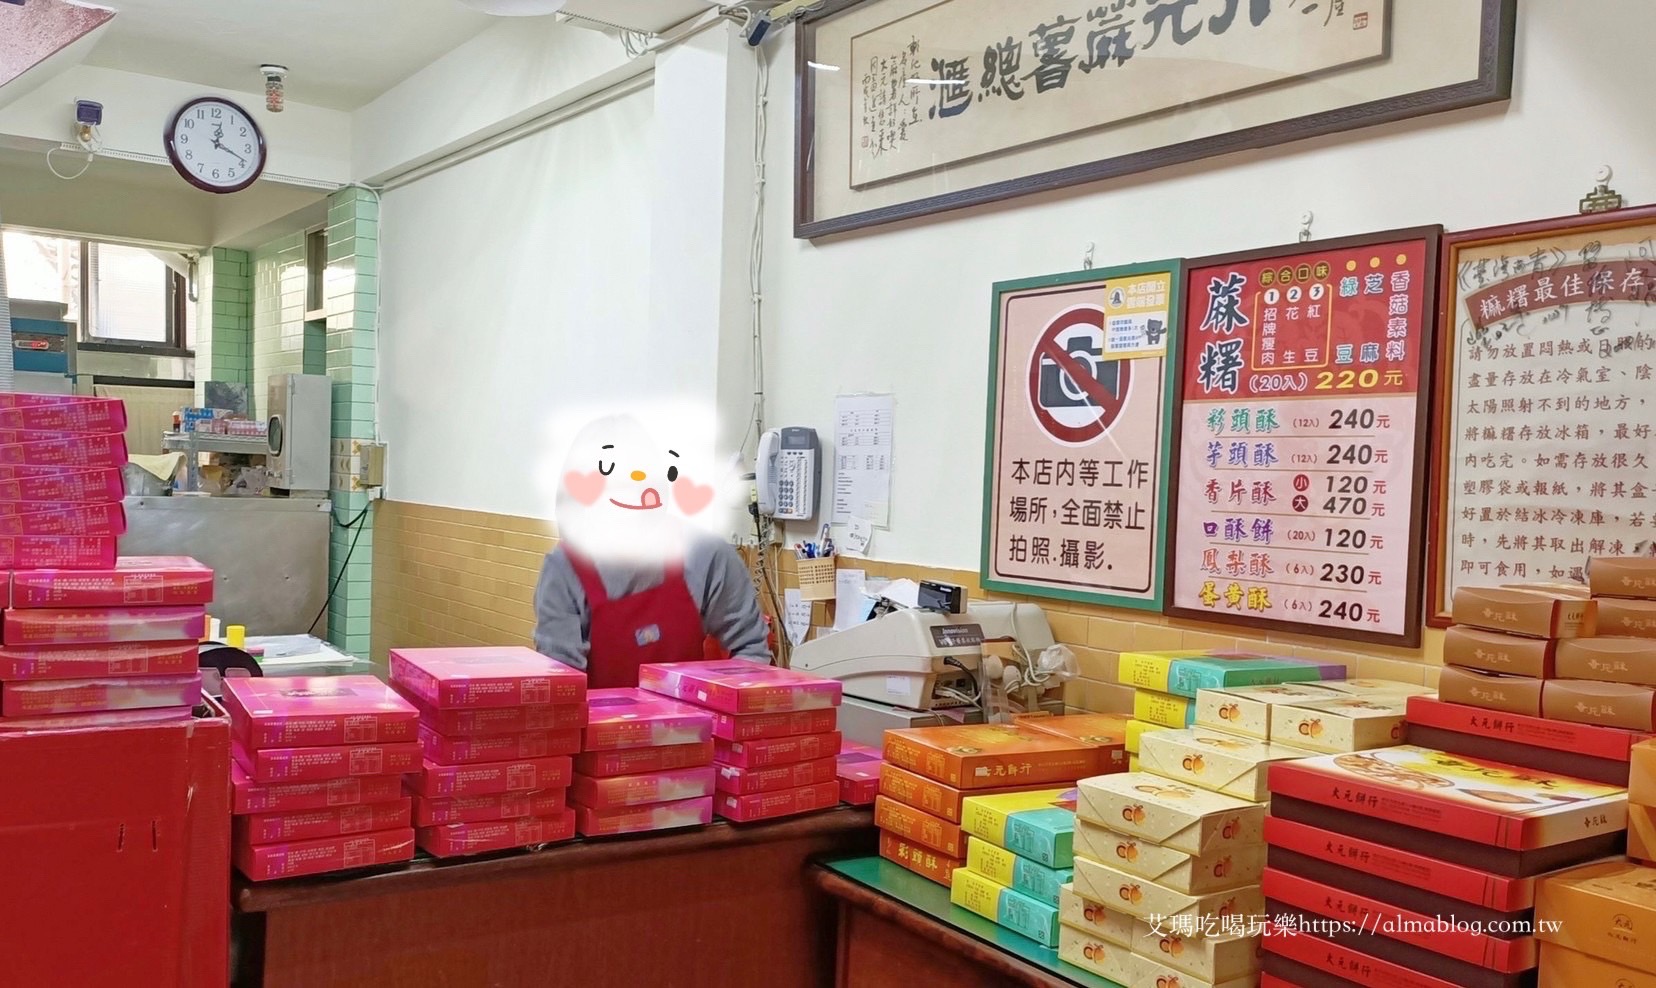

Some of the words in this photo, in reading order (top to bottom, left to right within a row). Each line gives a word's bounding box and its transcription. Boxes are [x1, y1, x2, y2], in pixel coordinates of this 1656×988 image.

[197, 109, 205, 120] 11
[211, 108, 222, 119] 12
[184, 118, 195, 129] 10
[240, 127, 247, 137] 2
[180, 133, 188, 144] 9
[185, 149, 193, 160] 8
[244, 144, 252, 154] 3
[197, 163, 204, 173] 7
[212, 168, 220, 179] 6
[228, 168, 235, 178] 5
[1260, 263, 1329, 286] 綜合口味
[1386, 270, 1410, 362] 香菇素料
[1207, 408, 1280, 435] 彩頭酥
[1207, 441, 1279, 467] 芋頭酥
[1204, 478, 1277, 505] 香片酥
[1294, 476, 1309, 490] 小
[1463, 479, 1656, 499] 塑膠袋或報紙，將其盒
[1293, 497, 1308, 511] 大
[1203, 518, 1274, 543] 口酥餅
[1200, 548, 1274, 577] 鳳梨酥
[1199, 581, 1273, 612] 蛋黃酥
